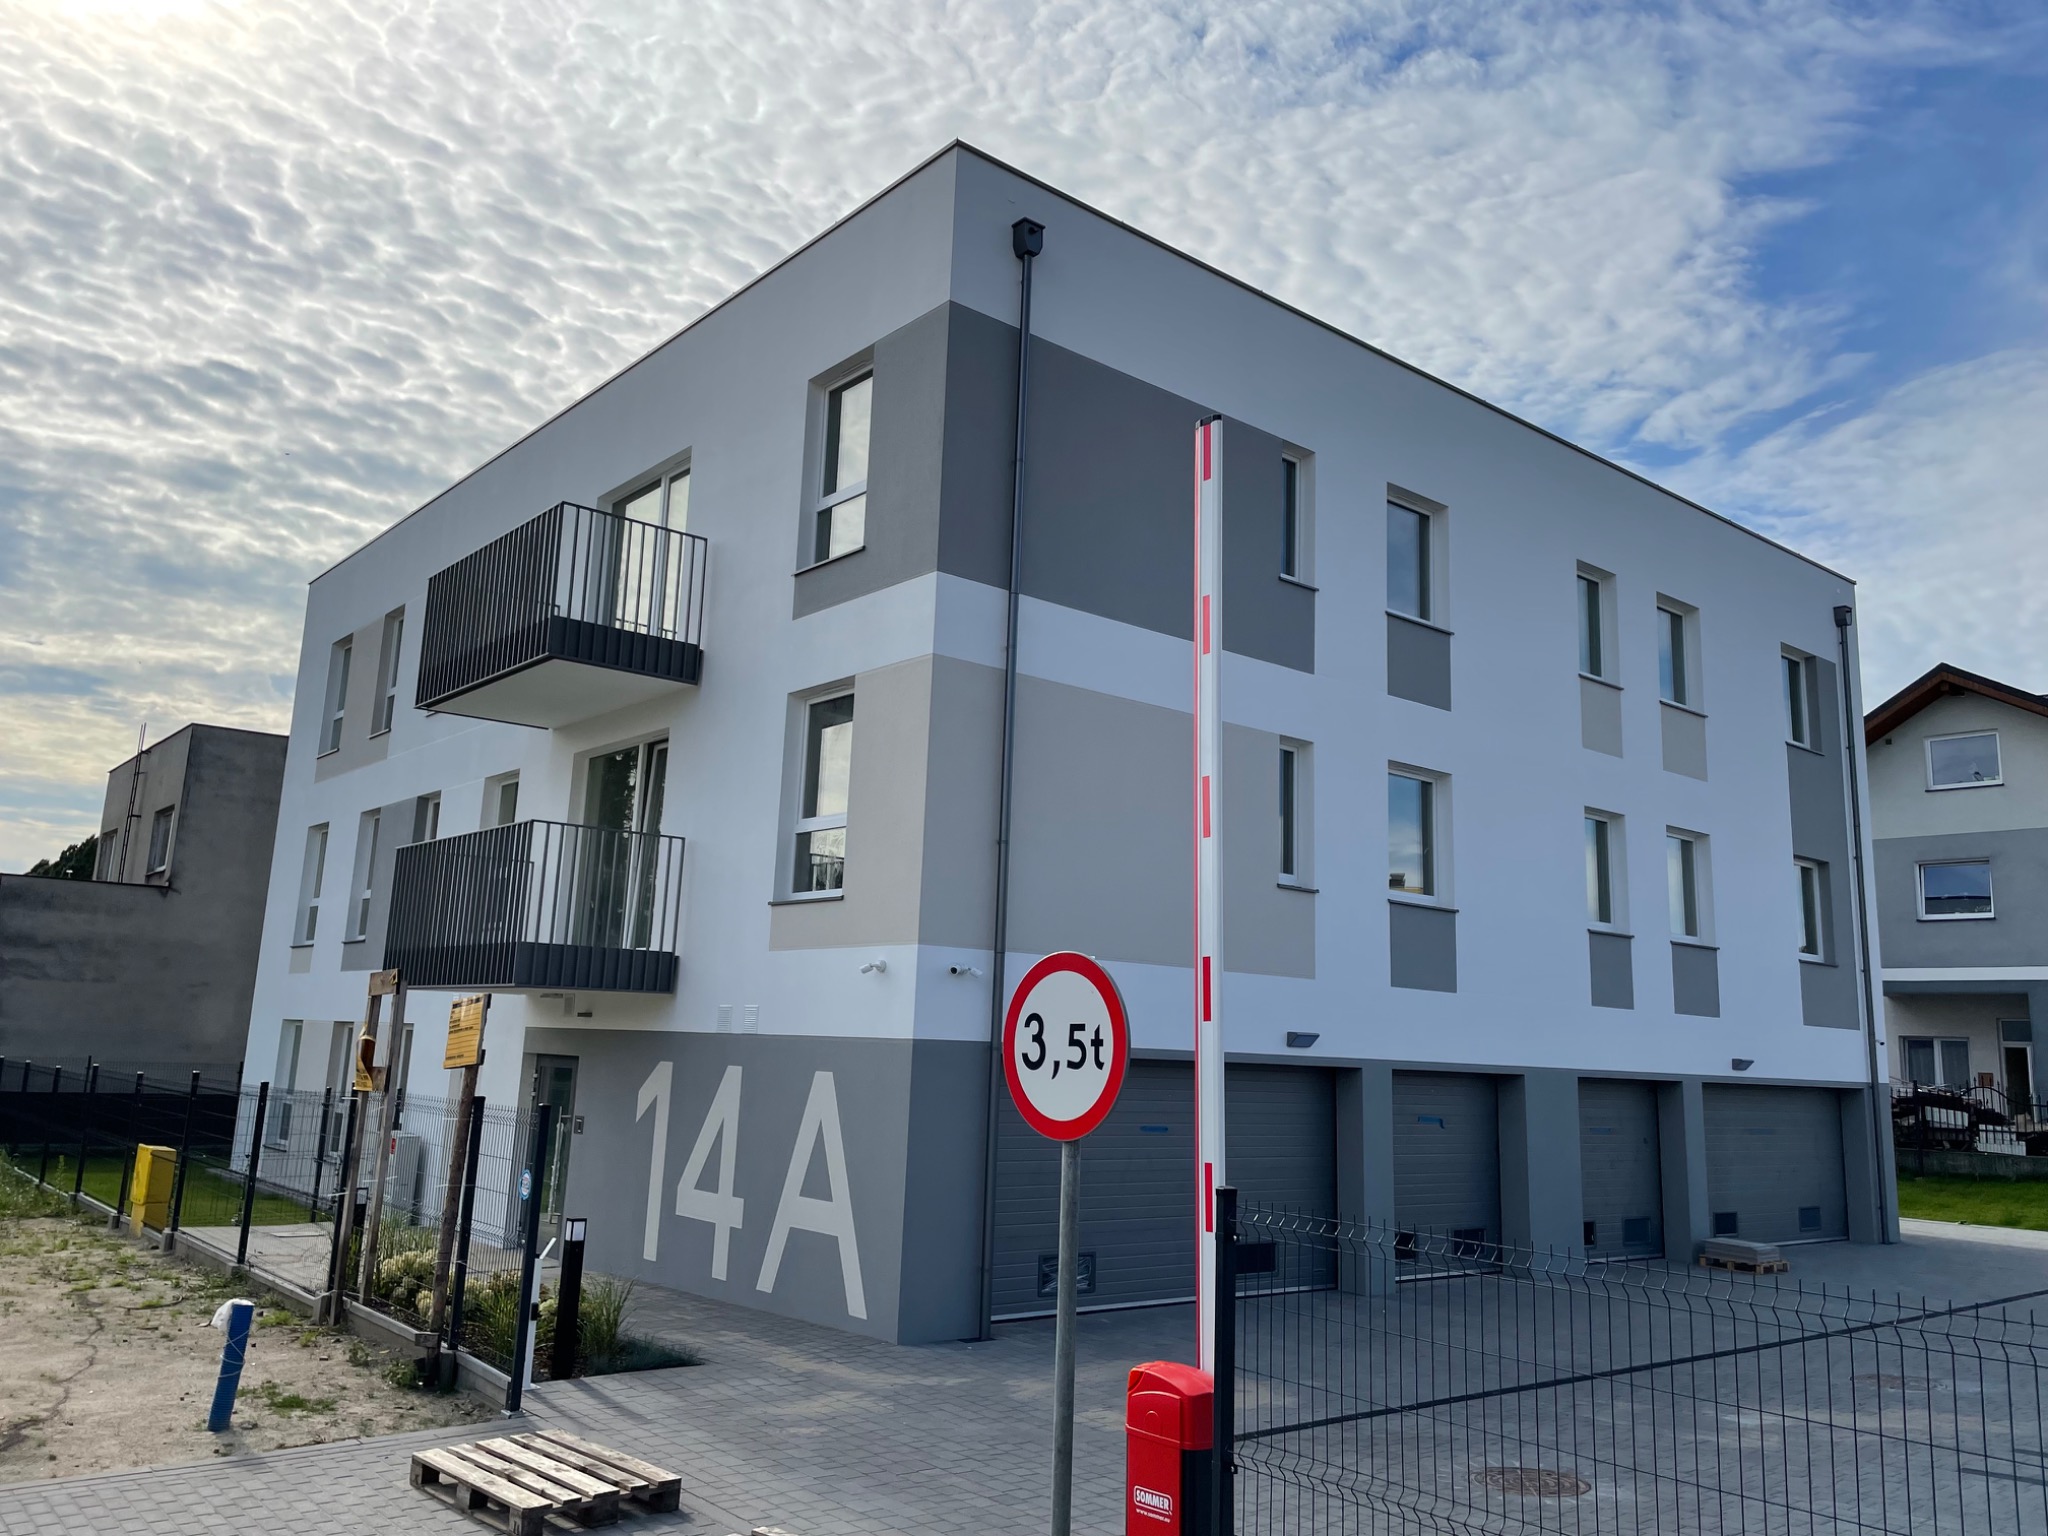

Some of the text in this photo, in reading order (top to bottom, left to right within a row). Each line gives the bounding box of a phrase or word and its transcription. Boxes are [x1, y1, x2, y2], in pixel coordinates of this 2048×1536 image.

[1021, 1012, 1105, 1080] 3,5t
[636, 1061, 868, 1320] 14A
[1136, 1489, 1169, 1511] SOMMER
